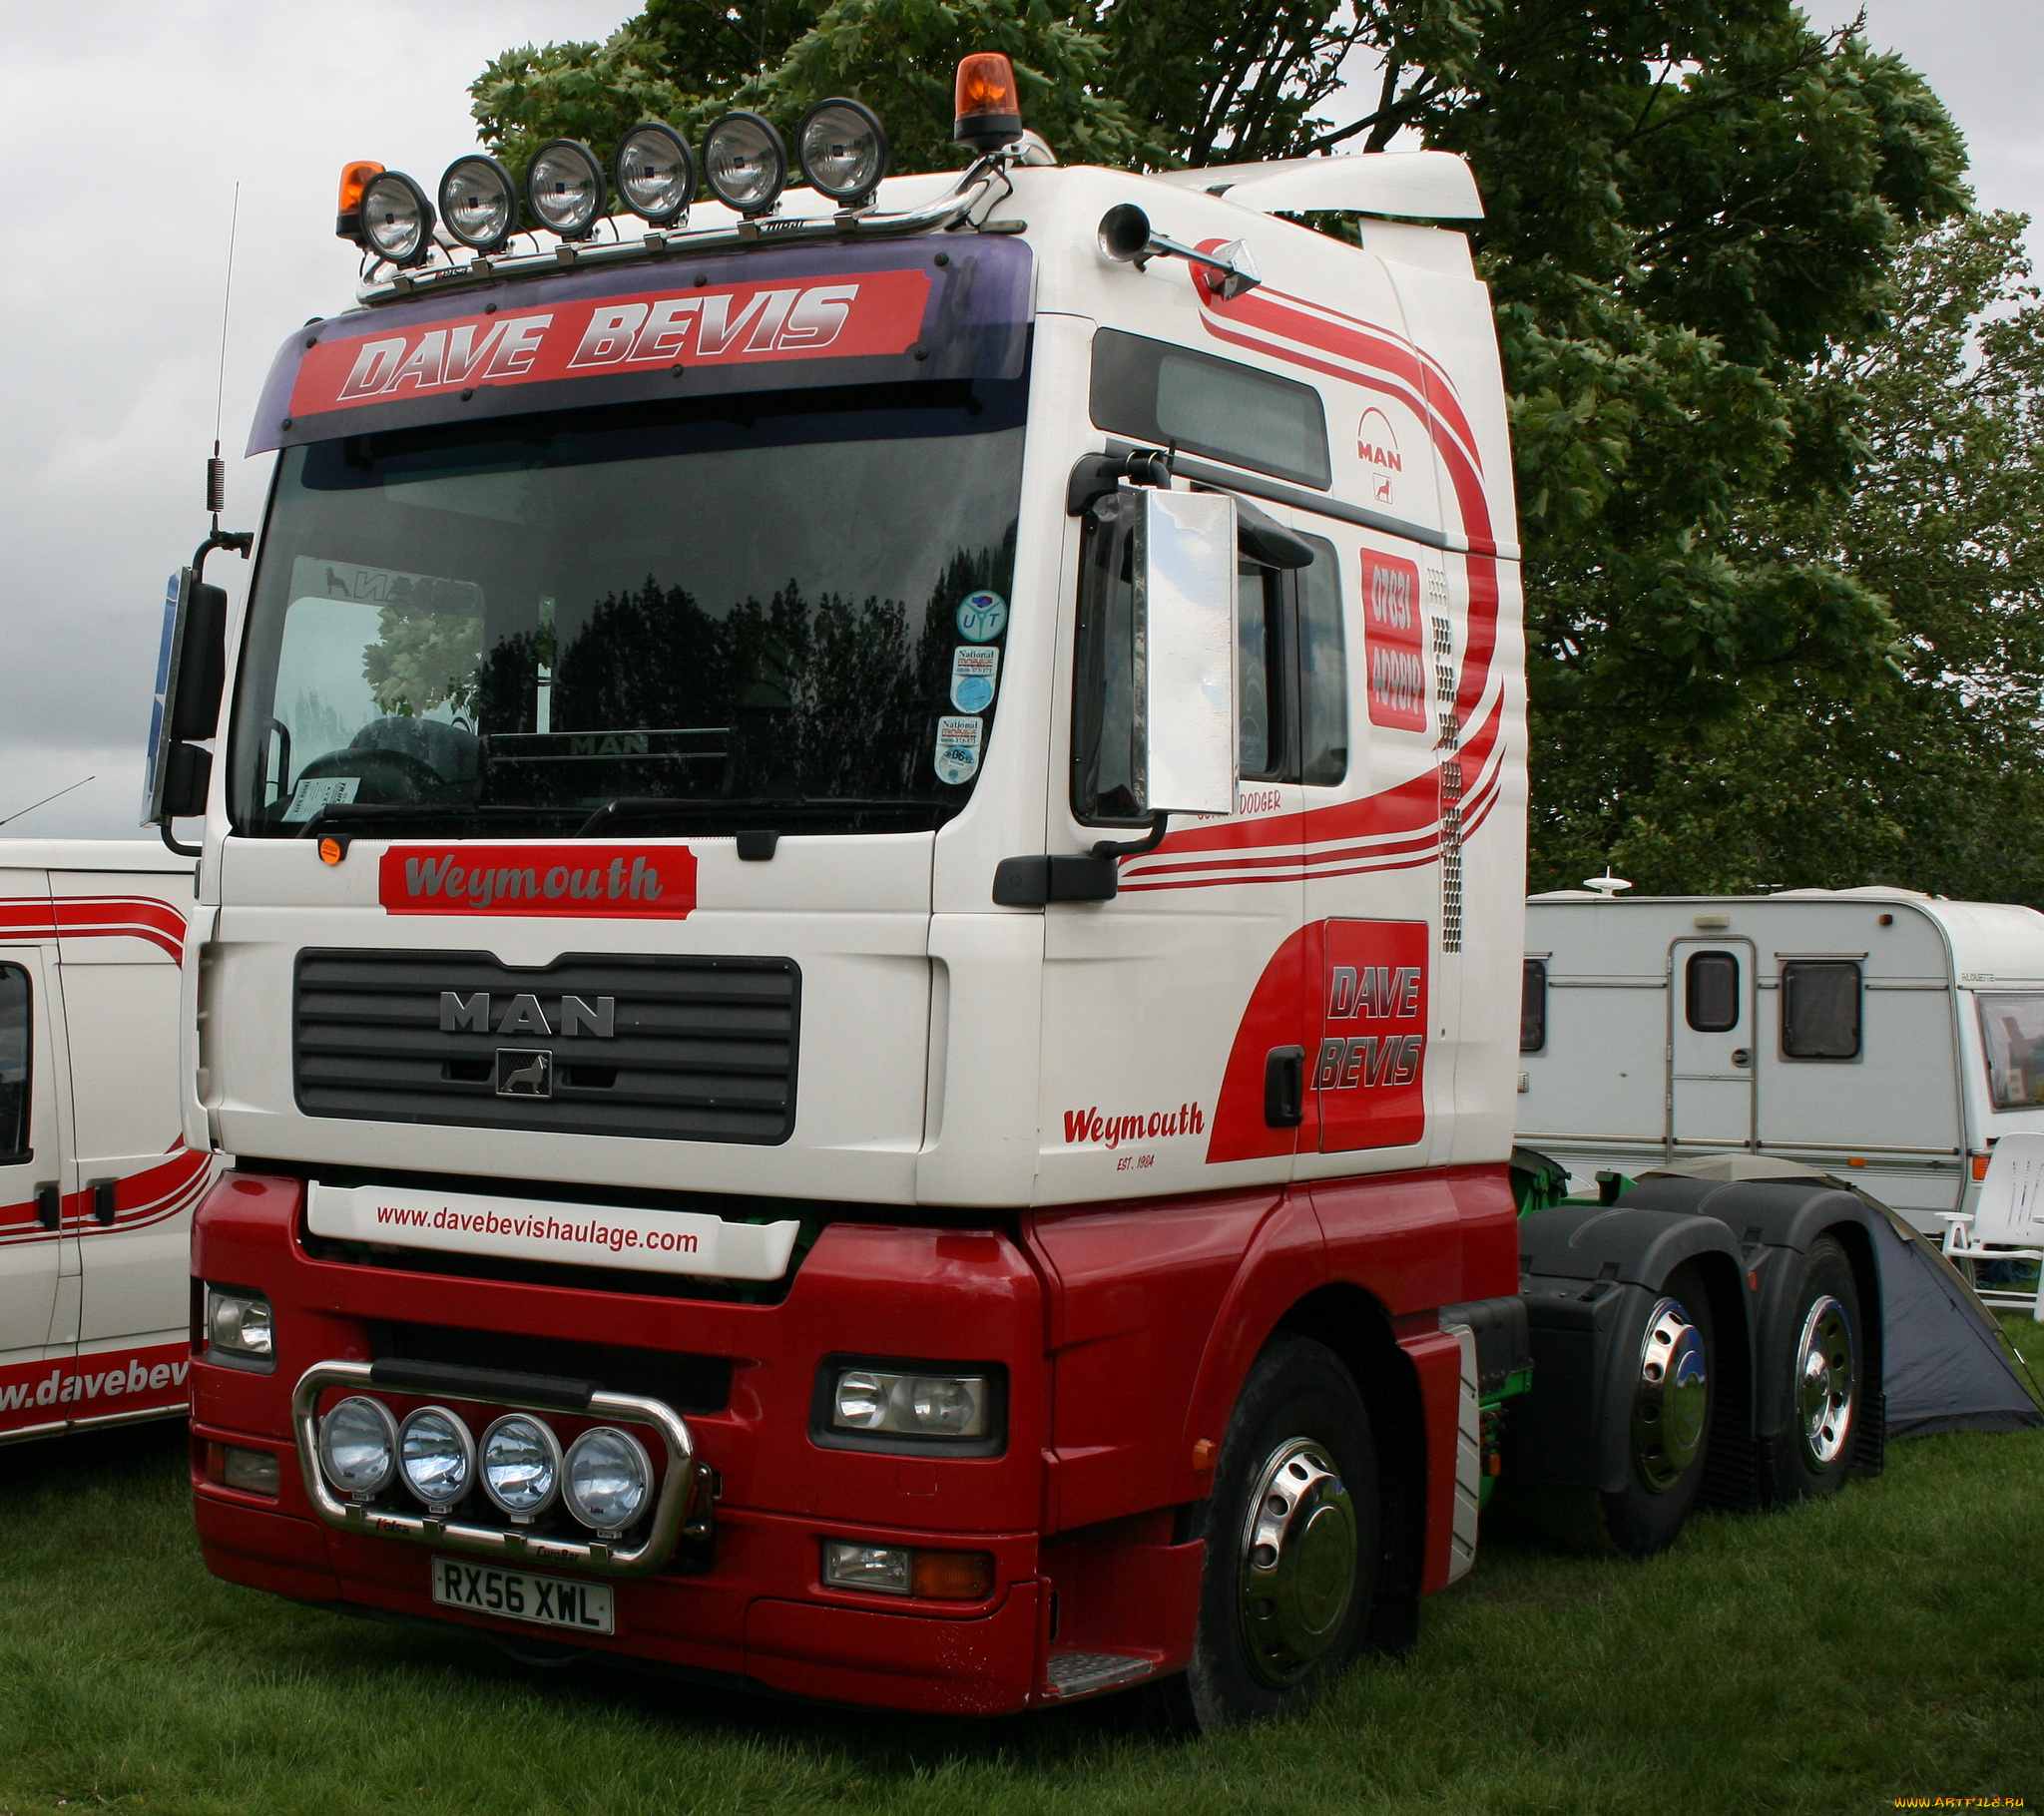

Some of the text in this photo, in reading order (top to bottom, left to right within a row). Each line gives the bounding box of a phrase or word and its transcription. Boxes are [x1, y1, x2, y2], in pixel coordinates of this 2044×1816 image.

[336, 283, 859, 401] DAVE BEVIS
[1357, 439, 1402, 472] MAN
[1371, 564, 1412, 631] 07831
[959, 649, 994, 659] National
[1371, 647, 1421, 714] 409819
[571, 735, 649, 755] MAN
[943, 720, 978, 730] National
[951, 749, 966, 761] 06
[1240, 789, 1282, 815] DODGER
[404, 854, 663, 909] Weymouth
[439, 992, 615, 1038] MAN
[1327, 966, 1421, 1020] DAVE
[1309, 1035, 1423, 1091] BEVIS
[1064, 1102, 1205, 1149] Weymouth
[1117, 1156, 1134, 1171] EST.
[376, 1206, 699, 1253] www.davebevishaulage.com
[376, 1518, 410, 1534] Kelsa
[444, 1564, 600, 1626] RX56 XWL
